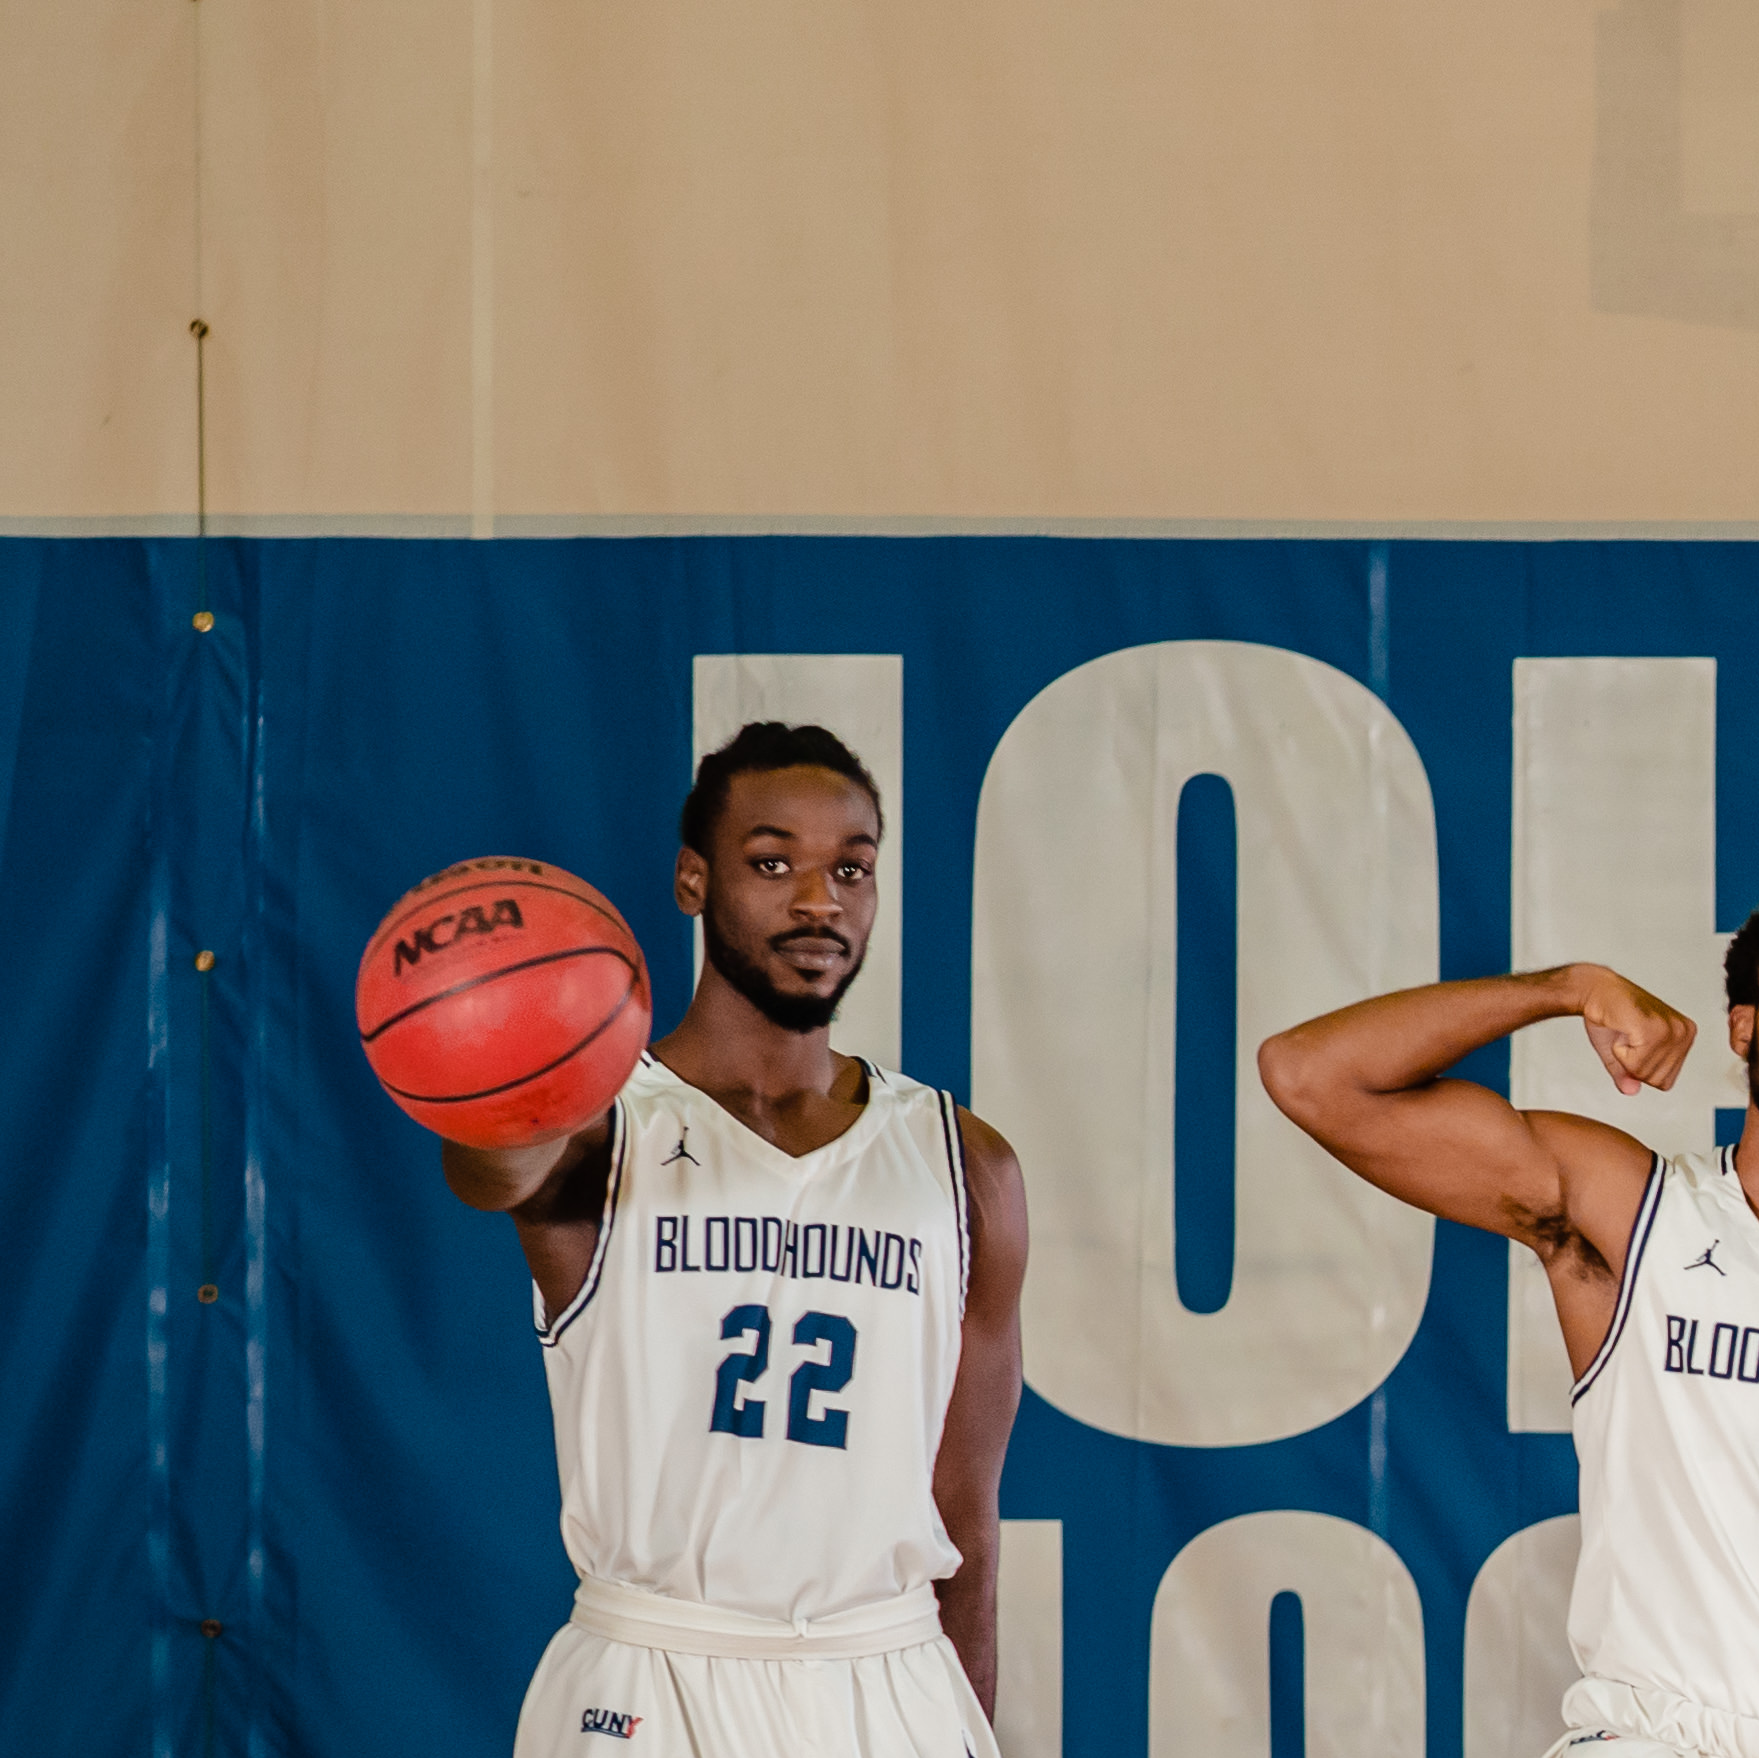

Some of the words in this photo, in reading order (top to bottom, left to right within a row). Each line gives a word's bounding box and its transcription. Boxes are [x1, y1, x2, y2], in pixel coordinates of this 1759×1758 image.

[394, 899, 524, 977] NCAA
[654, 1215, 922, 1296] BLOODHOUNDS
[709, 1303, 857, 1450] 22
[581, 1708, 644, 1739] CUNY
